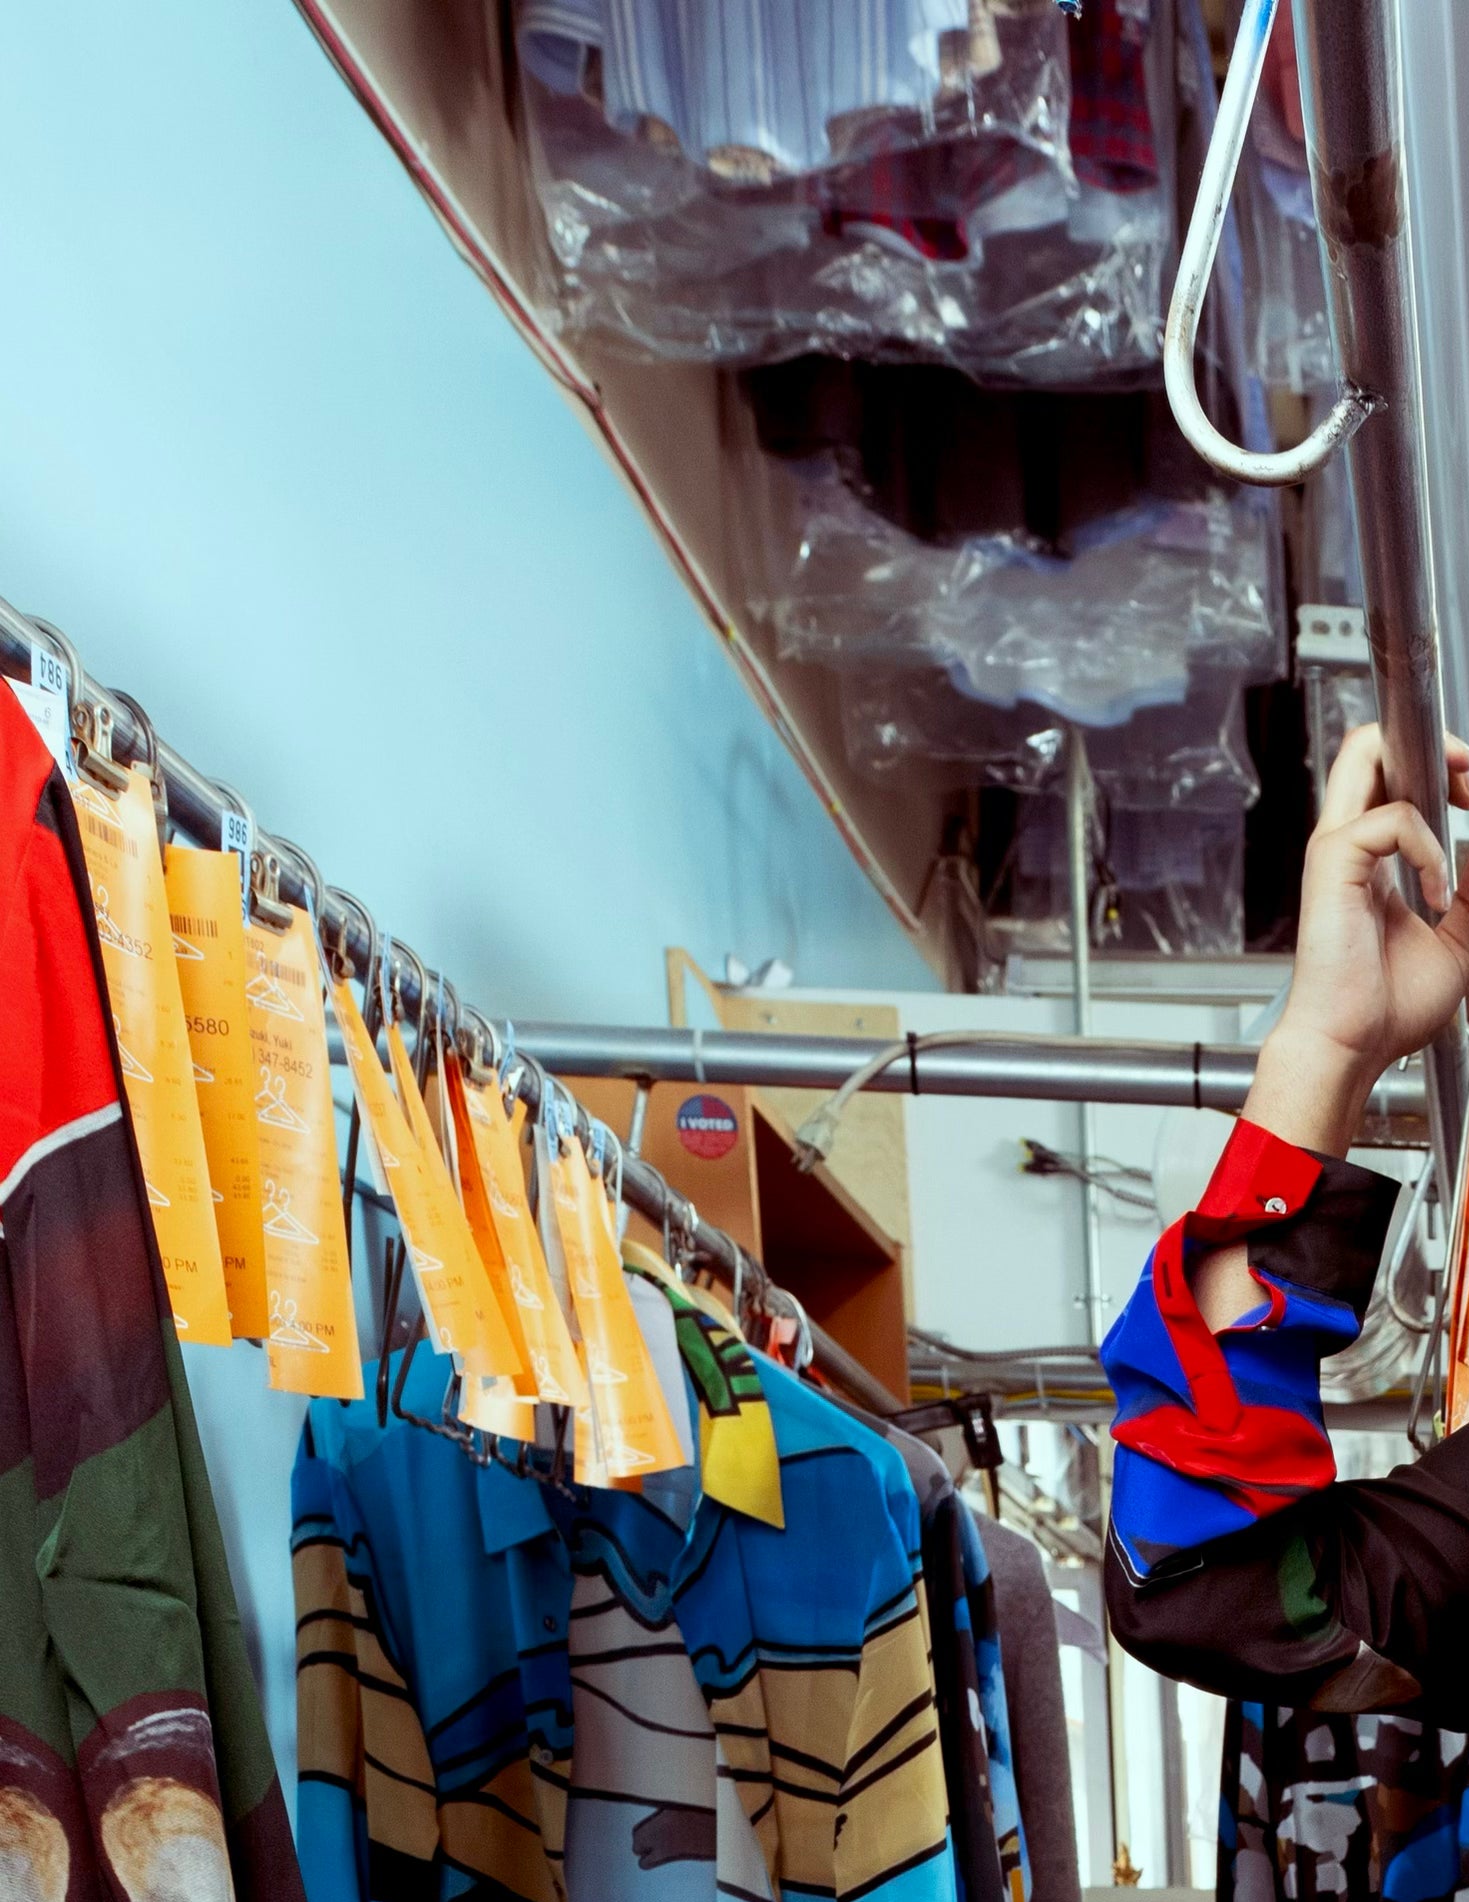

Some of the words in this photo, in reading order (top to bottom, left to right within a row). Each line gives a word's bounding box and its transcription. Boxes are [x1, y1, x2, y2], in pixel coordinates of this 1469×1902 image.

[228, 817, 248, 846] 986
[258, 1048, 313, 1079] 347-8452
[680, 1117, 687, 1130] I
[687, 1117, 734, 1132] VOTED
